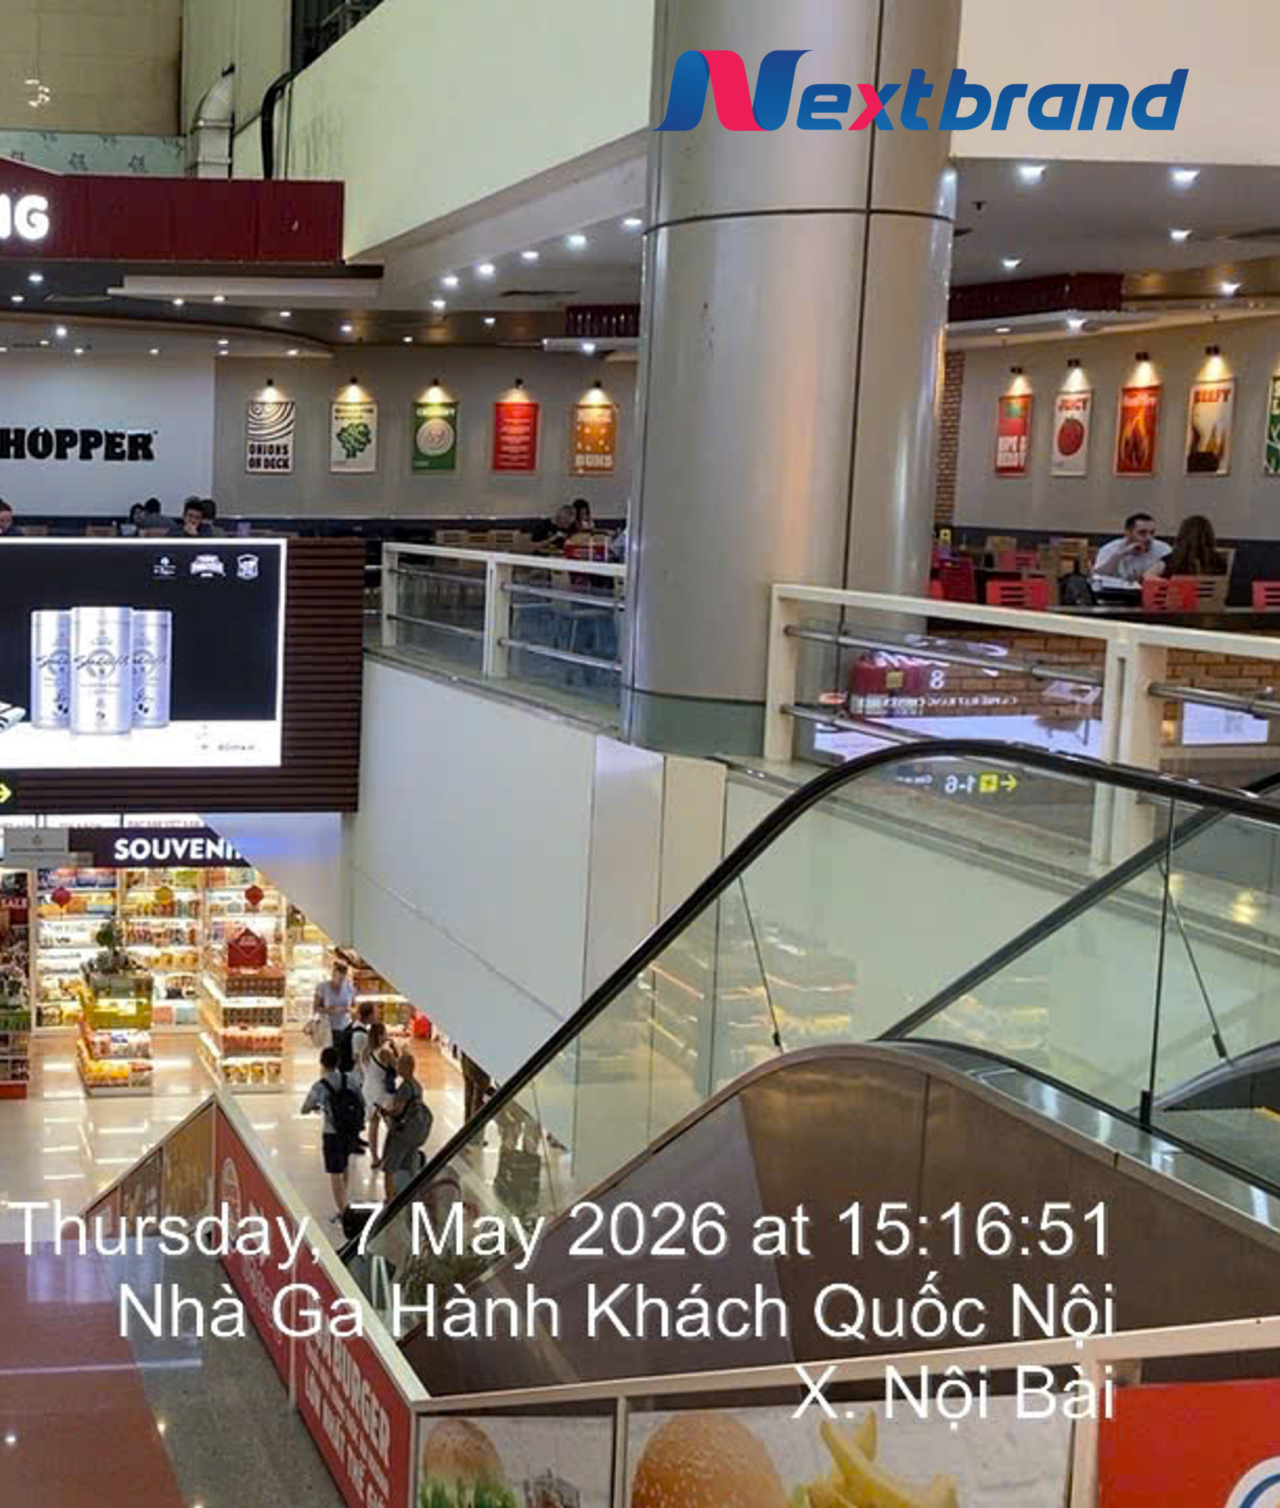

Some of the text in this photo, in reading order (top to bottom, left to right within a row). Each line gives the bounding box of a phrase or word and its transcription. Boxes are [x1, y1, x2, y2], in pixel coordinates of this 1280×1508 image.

[249, 443, 289, 455] ONIONS
[264, 457, 290, 470] DECK
[114, 838, 242, 860] SOUVENI
